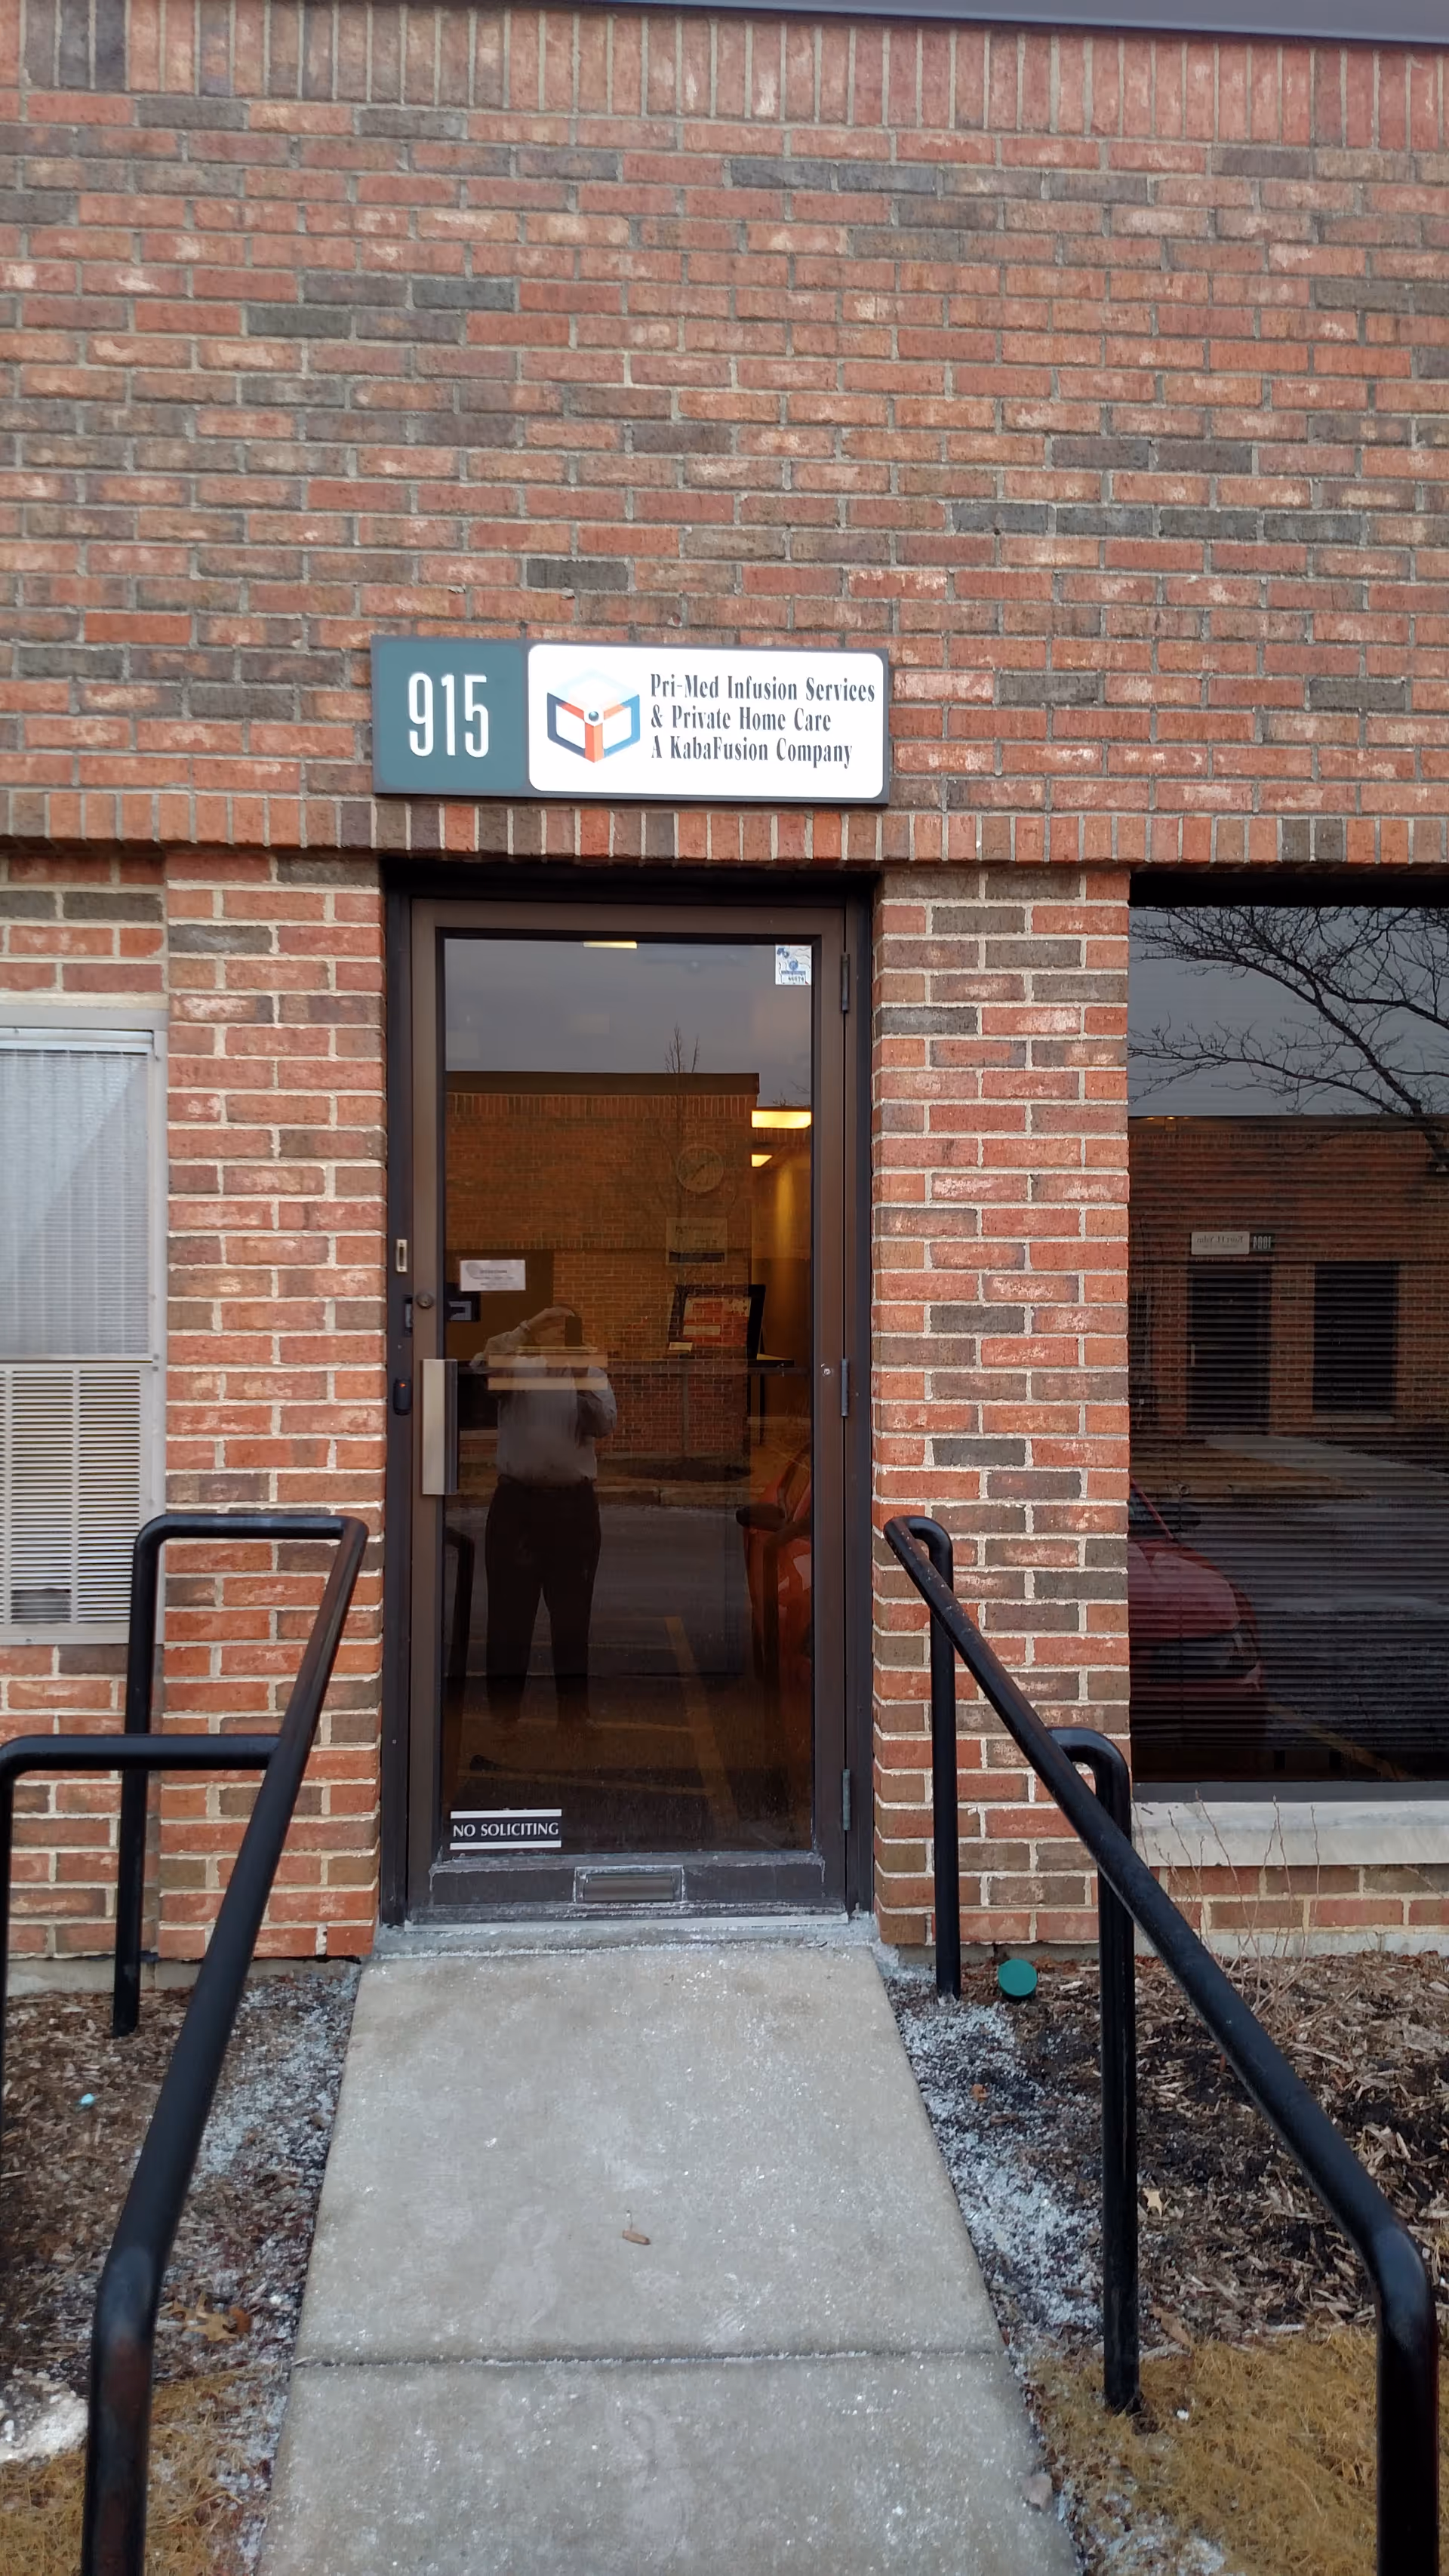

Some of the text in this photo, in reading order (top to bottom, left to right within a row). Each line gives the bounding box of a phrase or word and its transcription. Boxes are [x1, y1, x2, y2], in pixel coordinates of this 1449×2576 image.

[651, 673, 875, 702] Pri-Med Infusion Services
[408, 672, 490, 759] 915
[651, 704, 832, 731] & Private Home Care
[651, 734, 853, 769] A KabaFusion Company
[453, 1822, 559, 1837] NO SOLICITING
